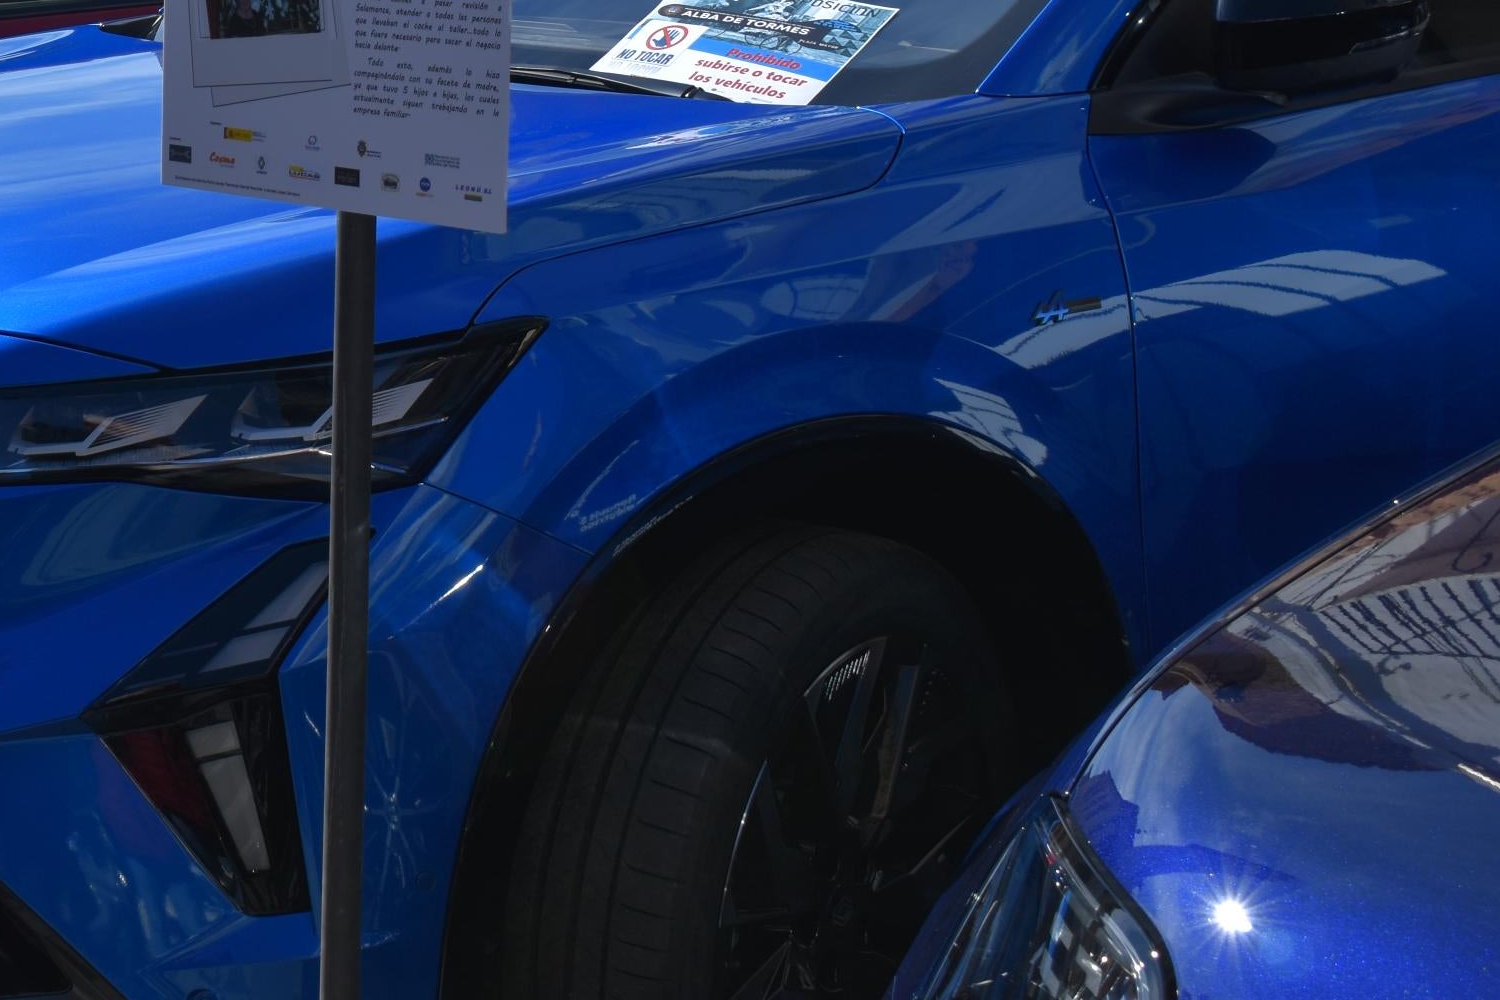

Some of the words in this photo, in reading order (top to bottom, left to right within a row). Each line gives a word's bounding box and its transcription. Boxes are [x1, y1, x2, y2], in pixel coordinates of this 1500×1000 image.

[681, 10, 719, 21] ALBA
[722, 15, 744, 24] DE
[746, 18, 811, 36] TORMES
[616, 49, 636, 62] NO
[636, 51, 674, 67] TOCAR
[726, 47, 802, 70] Prohibido
[695, 56, 750, 76] subirse
[752, 68, 762, 77] o
[765, 70, 809, 87] tocar
[688, 72, 713, 85] los
[715, 76, 787, 100] vehículos
